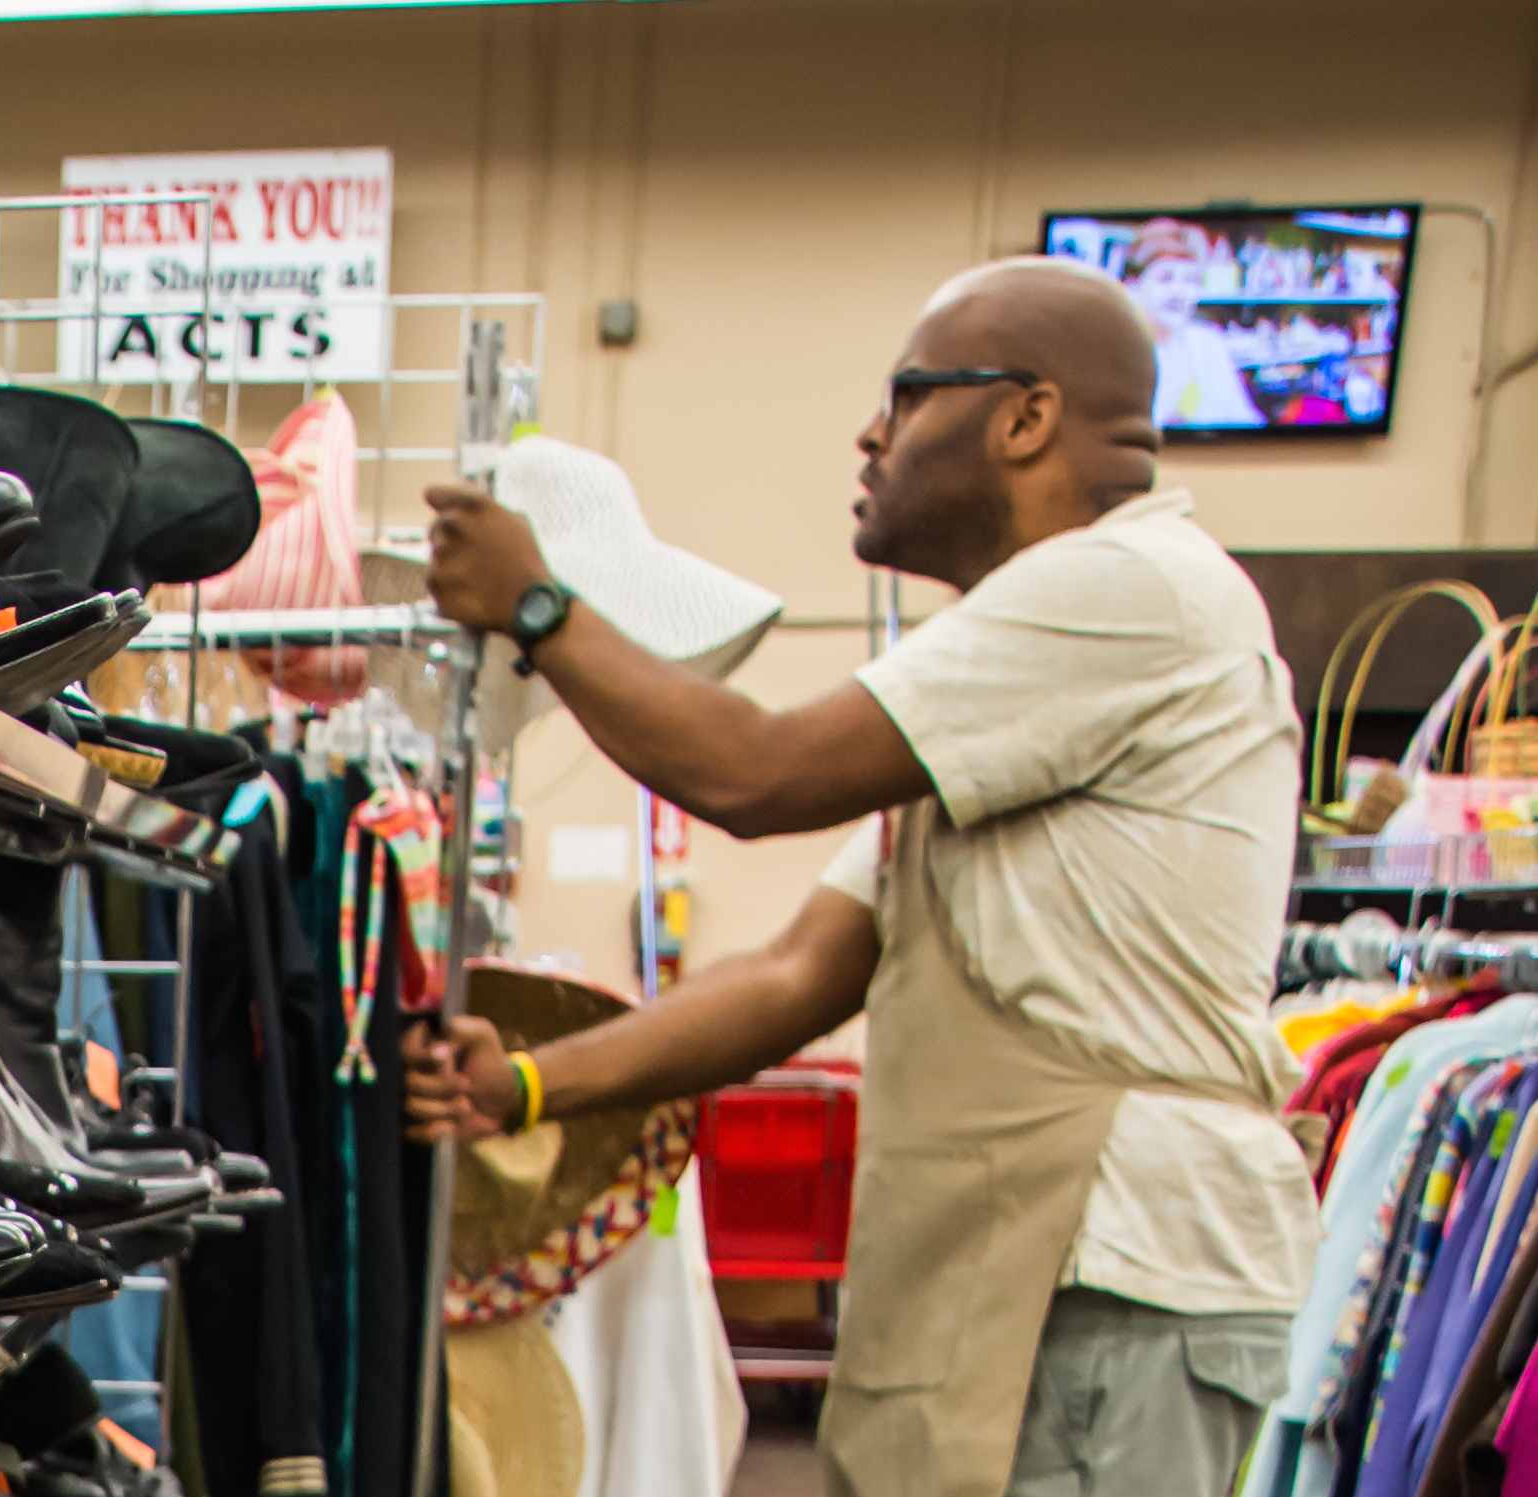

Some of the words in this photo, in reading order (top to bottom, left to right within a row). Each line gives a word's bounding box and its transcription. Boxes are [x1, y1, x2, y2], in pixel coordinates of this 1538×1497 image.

[66, 179, 238, 247] THANK
[147, 252, 325, 297] Shopping
[339, 250, 375, 289] at
[108, 308, 331, 362] ACTS
